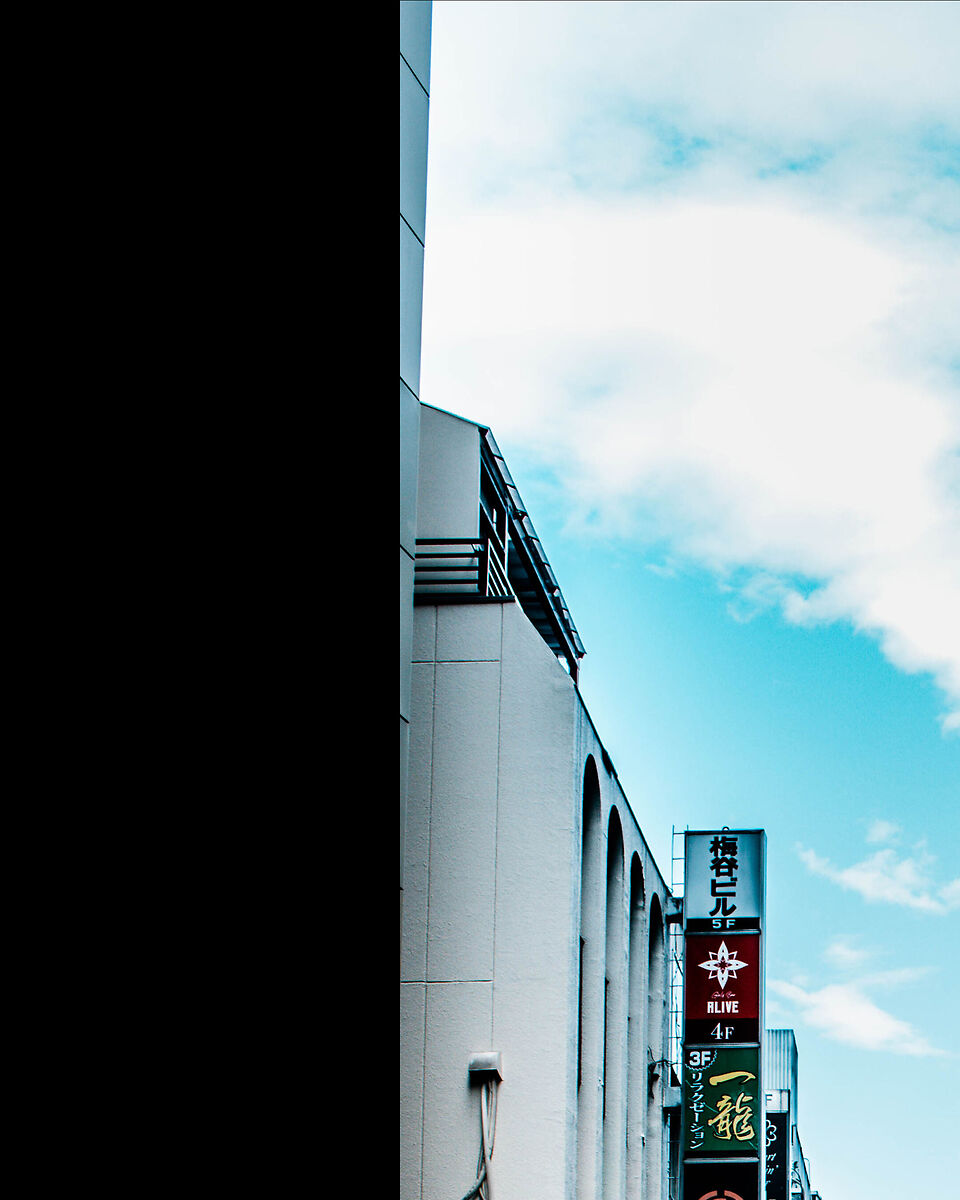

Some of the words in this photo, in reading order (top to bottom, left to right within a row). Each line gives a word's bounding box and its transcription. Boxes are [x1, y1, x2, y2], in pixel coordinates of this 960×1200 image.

[709, 836, 739, 917] 梅谷ビル
[711, 919, 736, 929] 5F
[707, 1001, 739, 1014] ALIVE
[711, 1022, 735, 1040] 4F
[689, 1051, 711, 1066] 3F
[690, 1071, 705, 1149] リラクゼーション
[708, 1071, 756, 1141] 一龍
